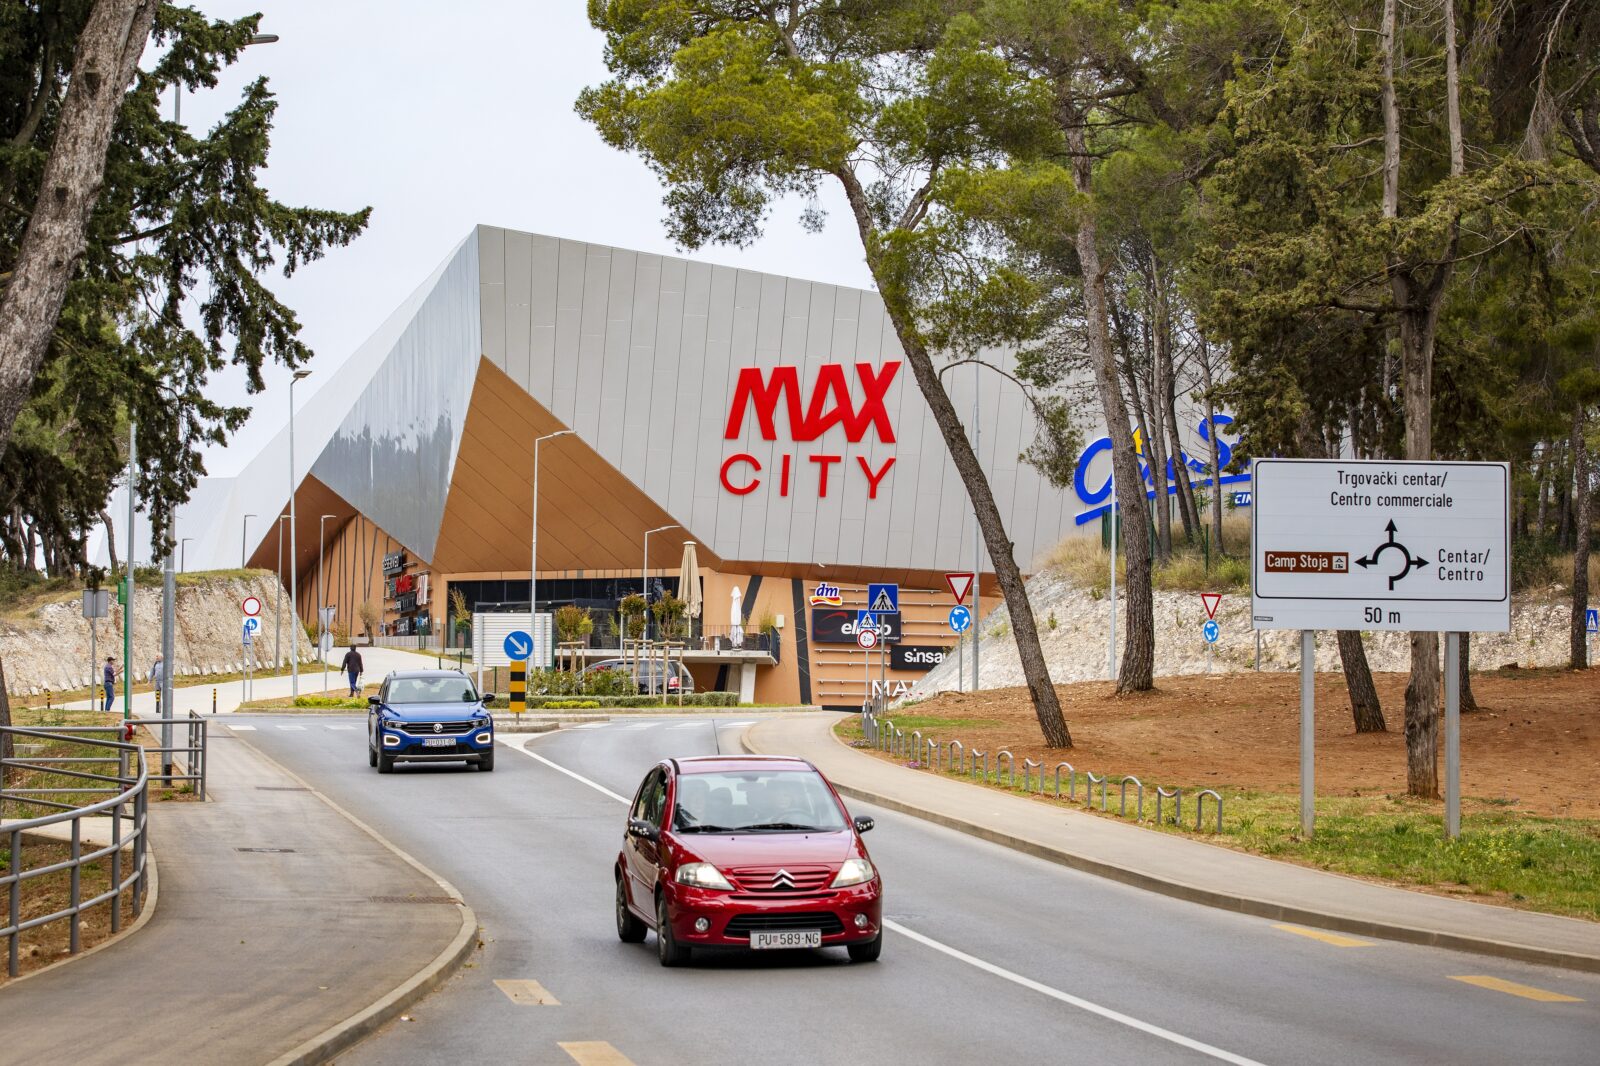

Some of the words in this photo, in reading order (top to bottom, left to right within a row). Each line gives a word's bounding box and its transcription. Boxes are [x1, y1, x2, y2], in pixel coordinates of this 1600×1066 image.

[725, 362, 901, 443] MAX
[720, 454, 896, 499] CITY
[1337, 470, 1398, 488] Trgovački
[1403, 472, 1448, 487] centar/
[1331, 491, 1371, 506] Centro
[1377, 493, 1452, 507] commerciale
[1267, 554, 1296, 569] Camp
[1300, 555, 1328, 570] Stoja
[1438, 549, 1490, 564] Centar/
[1438, 567, 1483, 581] Centro
[816, 583, 838, 597] dm
[1364, 607, 1382, 623] 50
[1388, 610, 1400, 623] m
[841, 619, 892, 636] elso
[872, 680, 918, 697] MA
[759, 935, 771, 945] PU
[780, 933, 818, 945] 589-NG
